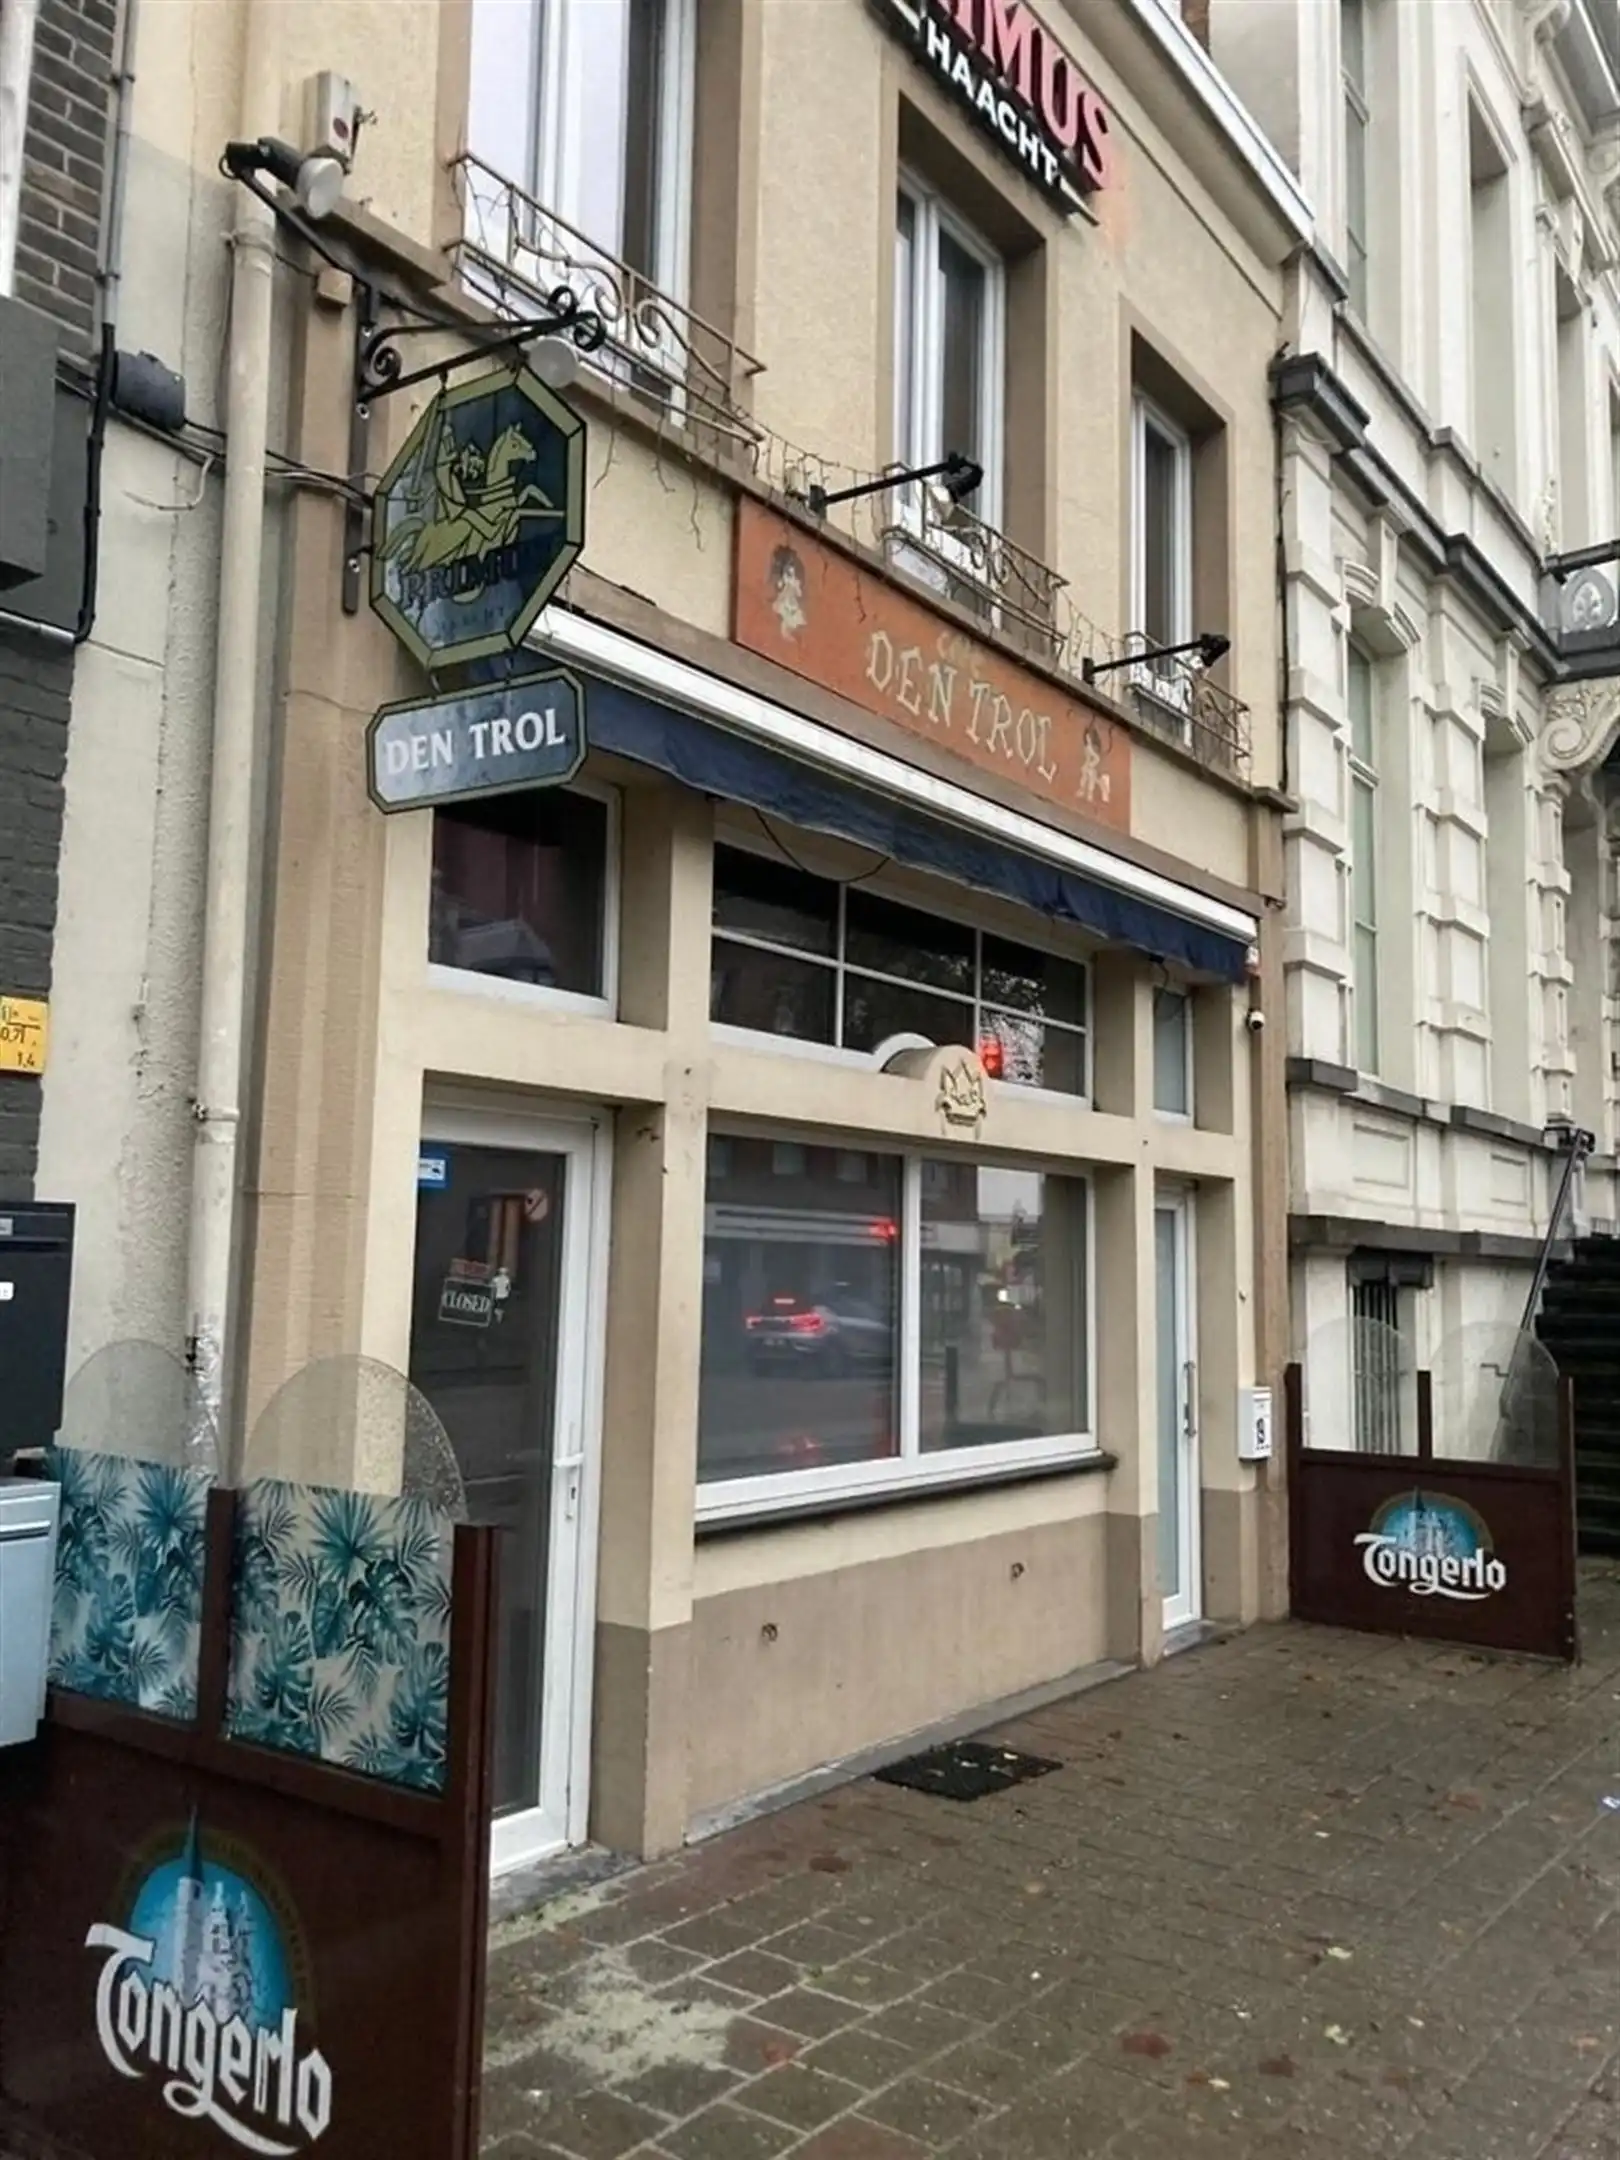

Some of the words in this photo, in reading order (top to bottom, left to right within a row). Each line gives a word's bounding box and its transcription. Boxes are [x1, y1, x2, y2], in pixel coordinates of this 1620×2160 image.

[926, 16, 1058, 185] HAACHT
[400, 546, 524, 612] PRIMU
[865, 630, 957, 728] DEN
[966, 679, 1057, 783] TROL
[385, 729, 452, 774] DEN
[468, 708, 567, 759] TROL
[441, 1289, 492, 1314] CLOSED
[1353, 1532, 1507, 1600] Tongerlo
[84, 1922, 332, 2156] Tongerlo
